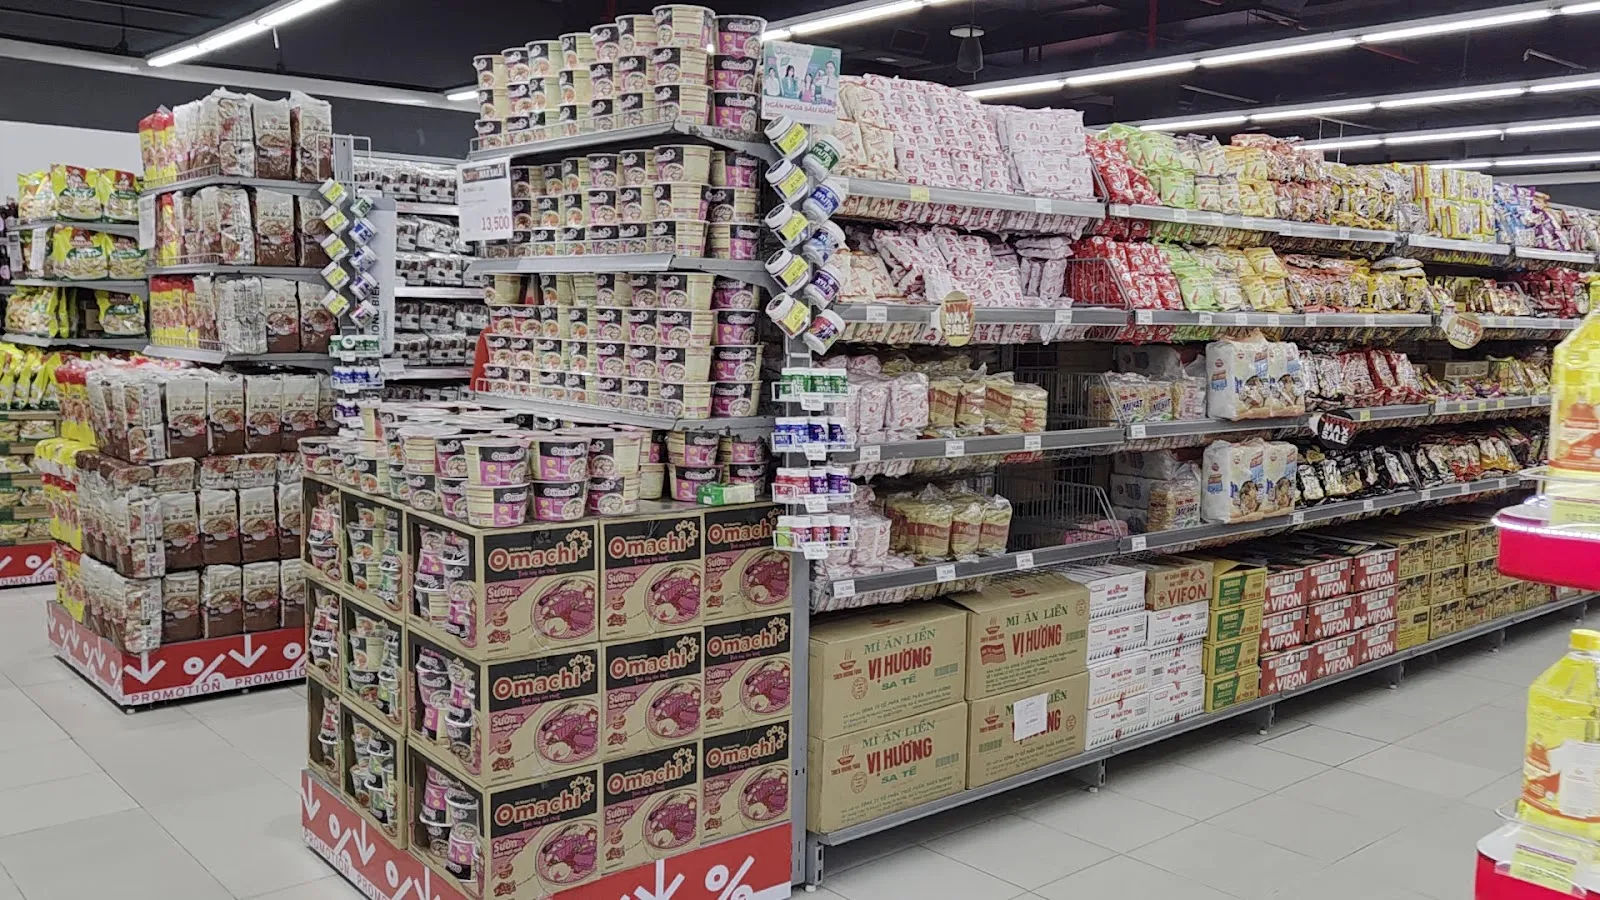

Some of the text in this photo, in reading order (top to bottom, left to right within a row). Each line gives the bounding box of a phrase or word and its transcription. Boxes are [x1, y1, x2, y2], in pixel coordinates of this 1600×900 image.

[482, 216, 510, 232] 13,500
[1322, 430, 1348, 444] SALE
[1323, 422, 1349, 436] MAX
[608, 530, 686, 558] Omachi
[488, 541, 578, 572] Omachi
[1318, 580, 1346, 599] VIFON
[1367, 571, 1394, 588] VIFON
[1168, 583, 1207, 605] VIFON
[1271, 592, 1302, 611] VIFON
[1368, 606, 1394, 624] VIFON
[1321, 618, 1351, 637] VIFON
[707, 626, 777, 657] Omachi
[1013, 632, 1024, 658] VỊ
[1269, 631, 1300, 650] VIFON
[1368, 641, 1393, 660] VIFON
[610, 646, 687, 679] Omachi
[868, 657, 882, 683] VỊ
[1325, 655, 1353, 676] VIFON
[131, 668, 306, 704] PROMOTION PROMOTIO
[493, 666, 580, 700] Omachi
[881, 681, 897, 691] SA
[1276, 671, 1307, 691] VIFON
[706, 736, 776, 768] Omachi
[866, 750, 881, 776] VỊ
[607, 759, 683, 795] Omachi
[881, 774, 898, 784] SA
[494, 787, 581, 826] Omachi
